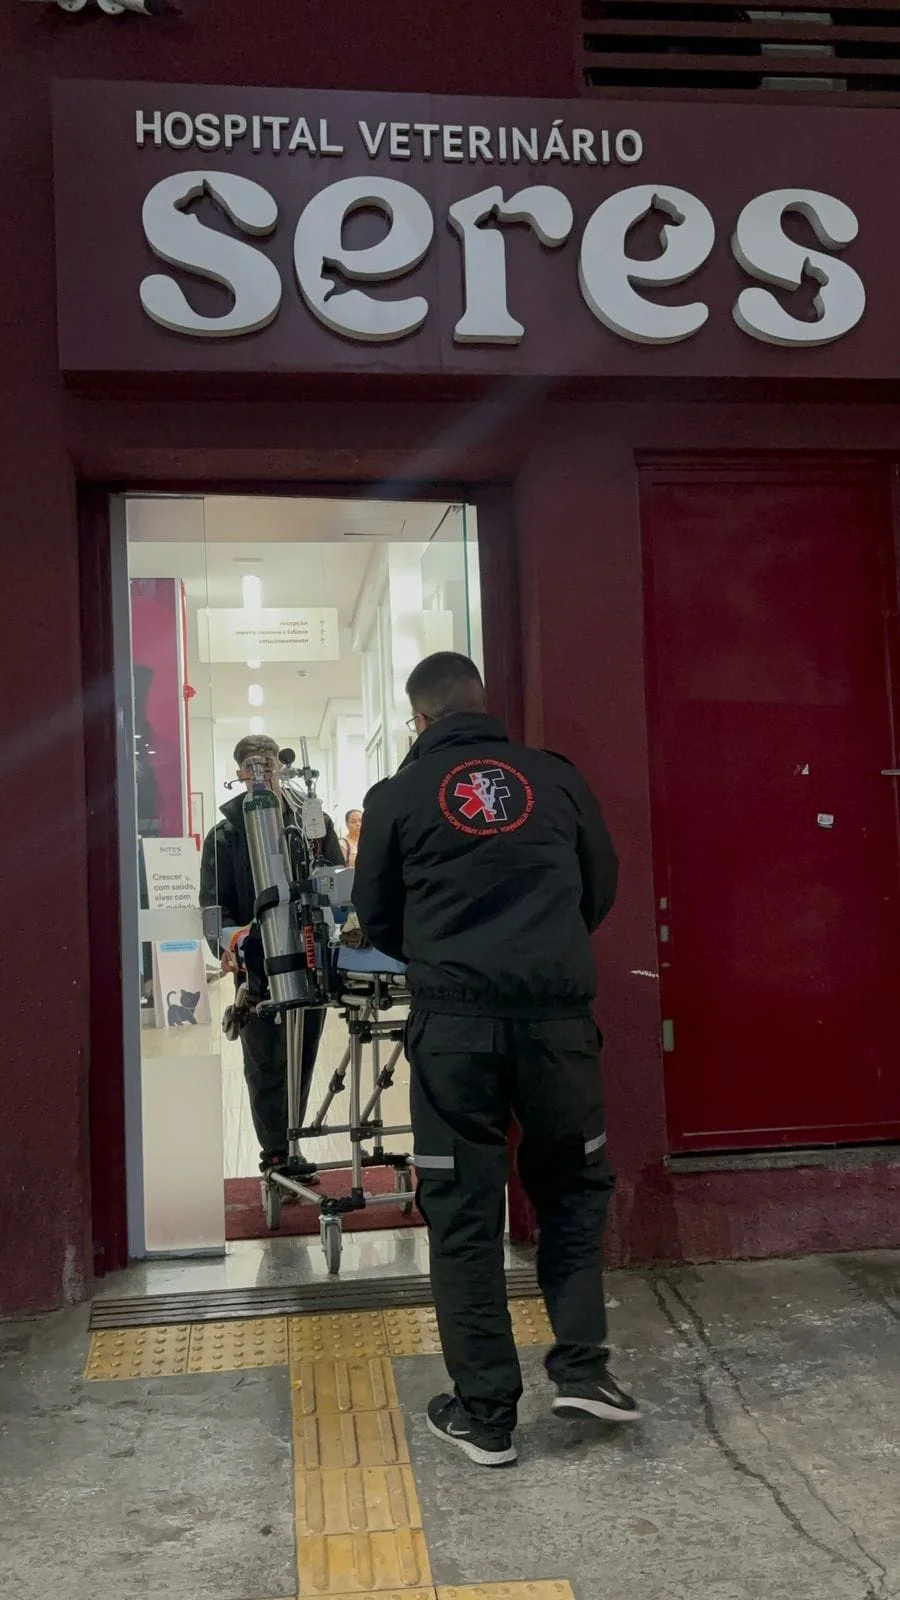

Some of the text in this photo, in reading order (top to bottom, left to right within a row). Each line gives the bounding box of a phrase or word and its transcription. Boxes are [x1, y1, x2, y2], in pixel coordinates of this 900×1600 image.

[135, 109, 645, 165] HOSPITAL VETERINÁRIO
[139, 170, 867, 346] seres
[152, 873, 182, 881] Crescer
[154, 893, 173, 901] viver
